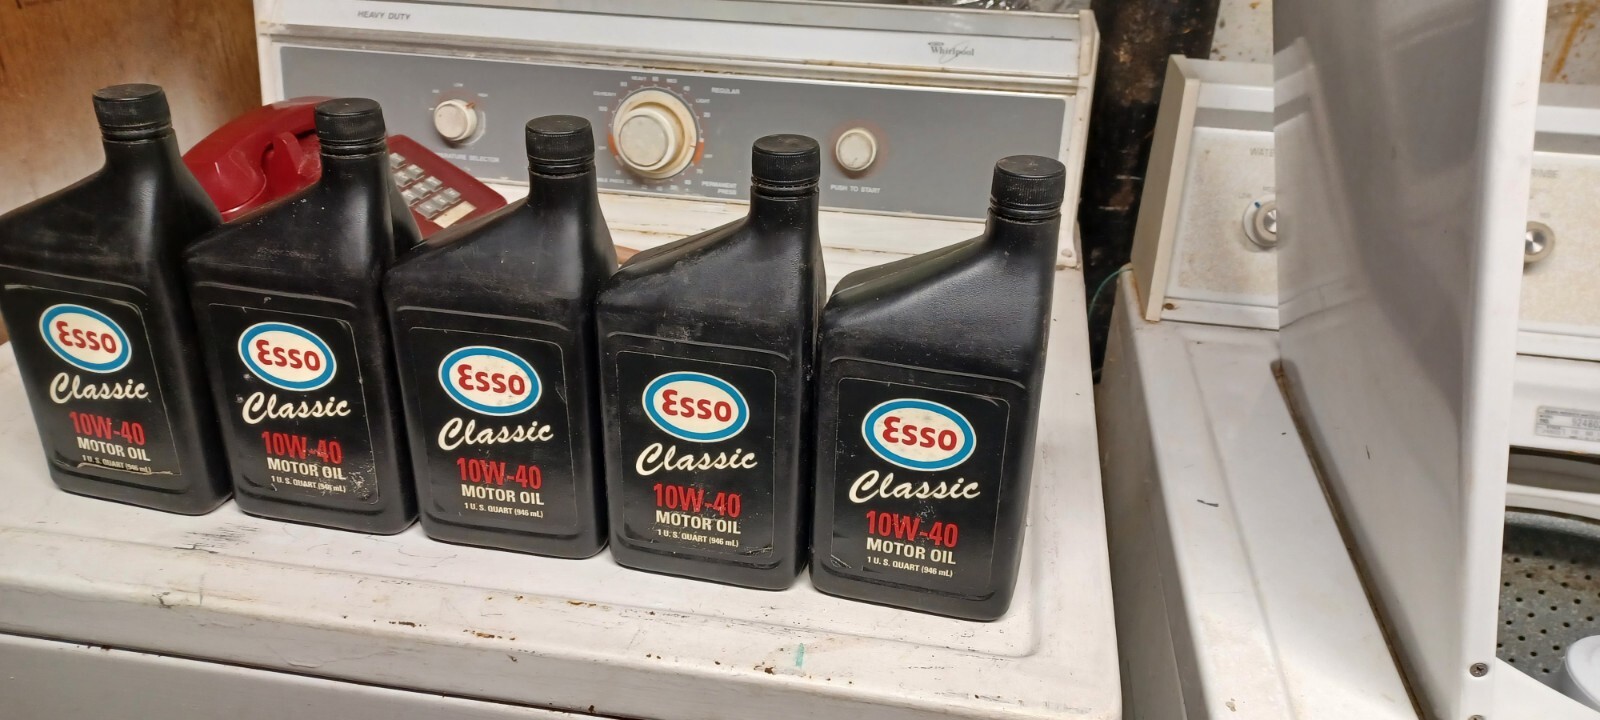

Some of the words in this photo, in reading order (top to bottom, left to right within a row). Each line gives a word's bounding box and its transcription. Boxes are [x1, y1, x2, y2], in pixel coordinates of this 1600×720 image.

[357, 10, 385, 18] HEAVY
[387, 12, 411, 20] DUTY
[930, 46, 975, 58] Whirlpool
[711, 86, 741, 94] REGULAR
[1250, 147, 1275, 158] WATE
[701, 180, 738, 189] PERMANENT
[830, 183, 848, 191] PUSH
[860, 186, 881, 194] START
[56, 321, 117, 354] Esso
[256, 339, 321, 371] Esso
[50, 372, 149, 404] Classic
[457, 364, 526, 396] Esso
[242, 391, 351, 424] Classic
[662, 389, 732, 422] Esso
[69, 411, 146, 446] 10W-40
[438, 417, 554, 451] Classic
[882, 416, 957, 451] Esso
[77, 436, 125, 458] MOTOR
[128, 446, 151, 462] OIL
[261, 431, 343, 464] 10W-40
[636, 443, 758, 476] Classic
[102, 458, 124, 469] QUART
[267, 457, 319, 477] MOTOR
[322, 466, 347, 480] OIL
[456, 457, 542, 490] 10W-40
[293, 479, 317, 489] QUART
[461, 483, 516, 503] MOTOR
[519, 491, 545, 505] OIL
[849, 470, 980, 504] Classic
[479, 504, 487, 512] S.
[487, 505, 512, 515] QUART
[514, 508, 529, 517] (946
[530, 510, 544, 518] mL)
[653, 483, 741, 518] 10W-40
[656, 510, 712, 531] MOTOR
[716, 520, 741, 534] OIL
[866, 510, 959, 548] 10W-40
[663, 530, 671, 538] U.
[673, 531, 680, 539] S.
[681, 533, 707, 543] QUART
[709, 536, 724, 545] (946
[725, 539, 739, 548] mL)
[866, 537, 925, 560] MOTOR
[930, 550, 956, 565] OIL
[873, 557, 881, 565] U.
[883, 558, 890, 566] S.
[892, 560, 920, 572] QUART
[921, 566, 937, 576] (946
[938, 569, 953, 578] mL)
